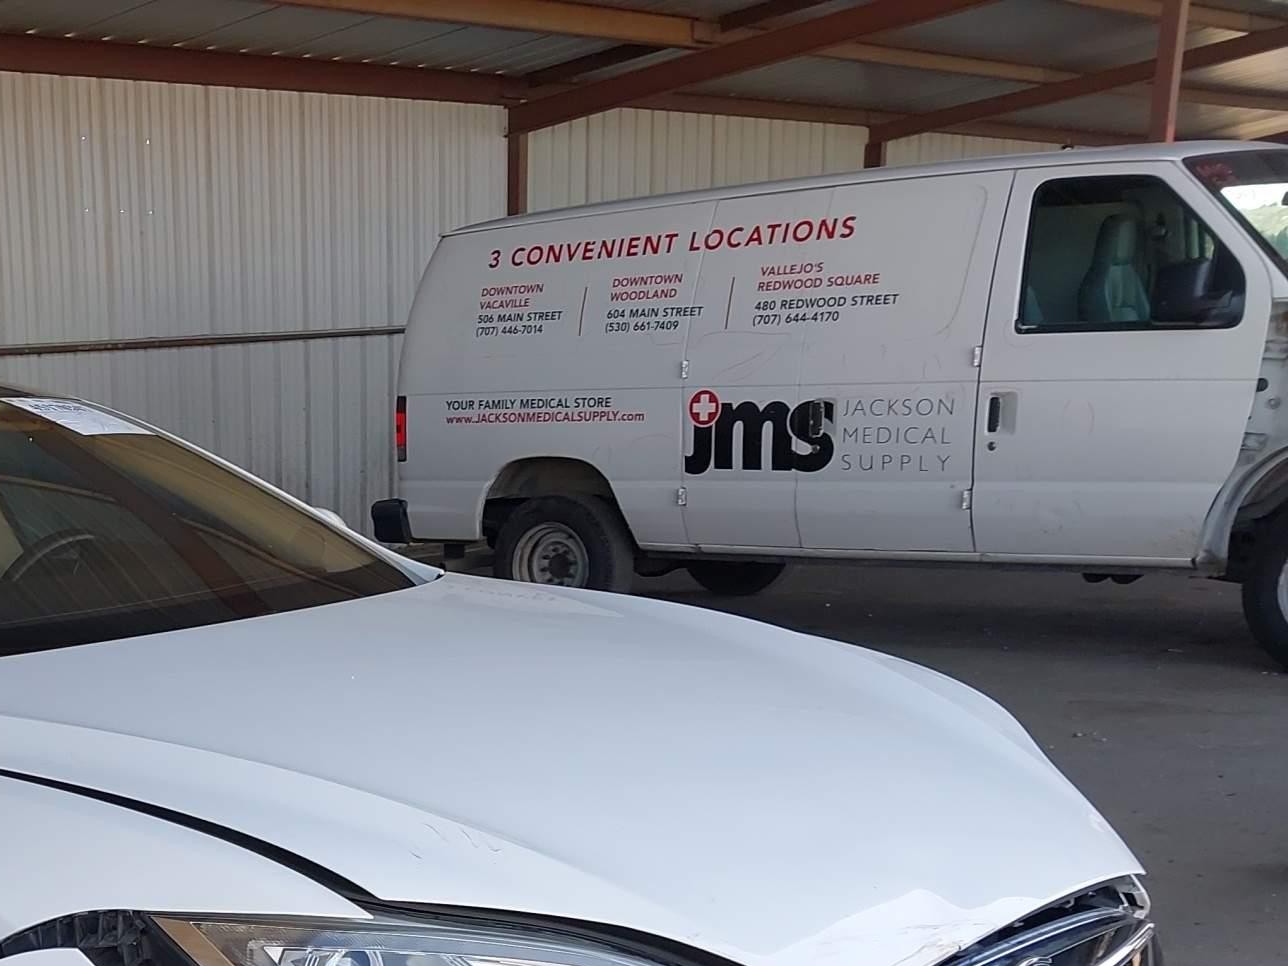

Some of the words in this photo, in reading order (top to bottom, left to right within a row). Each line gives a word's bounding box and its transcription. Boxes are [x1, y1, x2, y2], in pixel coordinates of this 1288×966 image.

[488, 250, 501, 268] 3
[511, 233, 679, 267] CONVENIENT
[688, 216, 857, 251] LOCATIONS
[761, 262, 824, 276] VALLEJO'S
[613, 274, 683, 288] DOWNTOWN
[758, 277, 823, 292] REDWOOD
[827, 273, 880, 287] SQUARE
[481, 284, 544, 297] DOWNTOWN
[610, 289, 677, 302] WOODLAND
[480, 298, 530, 310] VACAVILLE
[754, 301, 776, 311] 480
[780, 297, 848, 310] REDWOOD
[851, 293, 899, 306] STREET
[477, 314, 494, 324] 506
[497, 313, 524, 323] MAIN
[527, 310, 563, 321] STREET
[607, 310, 626, 319] 604
[629, 308, 659, 318] MAIN
[662, 306, 704, 317] STREET
[752, 314, 781, 327] (707)
[785, 311, 839, 323] 644-4170
[476, 326, 499, 337] (707)
[501, 325, 543, 336] 446-7014
[605, 322, 630, 334] (530)
[633, 320, 680, 332] 661-7409
[446, 400, 475, 411] YOUR
[478, 399, 516, 410] FAMILY
[519, 398, 571, 409] MEDICAL
[574, 397, 612, 408] STORE
[842, 398, 956, 417] JACKSON
[446, 411, 645, 424] www.JACKSONMEDICALSUPPLY.com
[684, 390, 835, 475] jms
[842, 427, 952, 444] MEDICAL
[841, 454, 951, 472] SUPPLY
